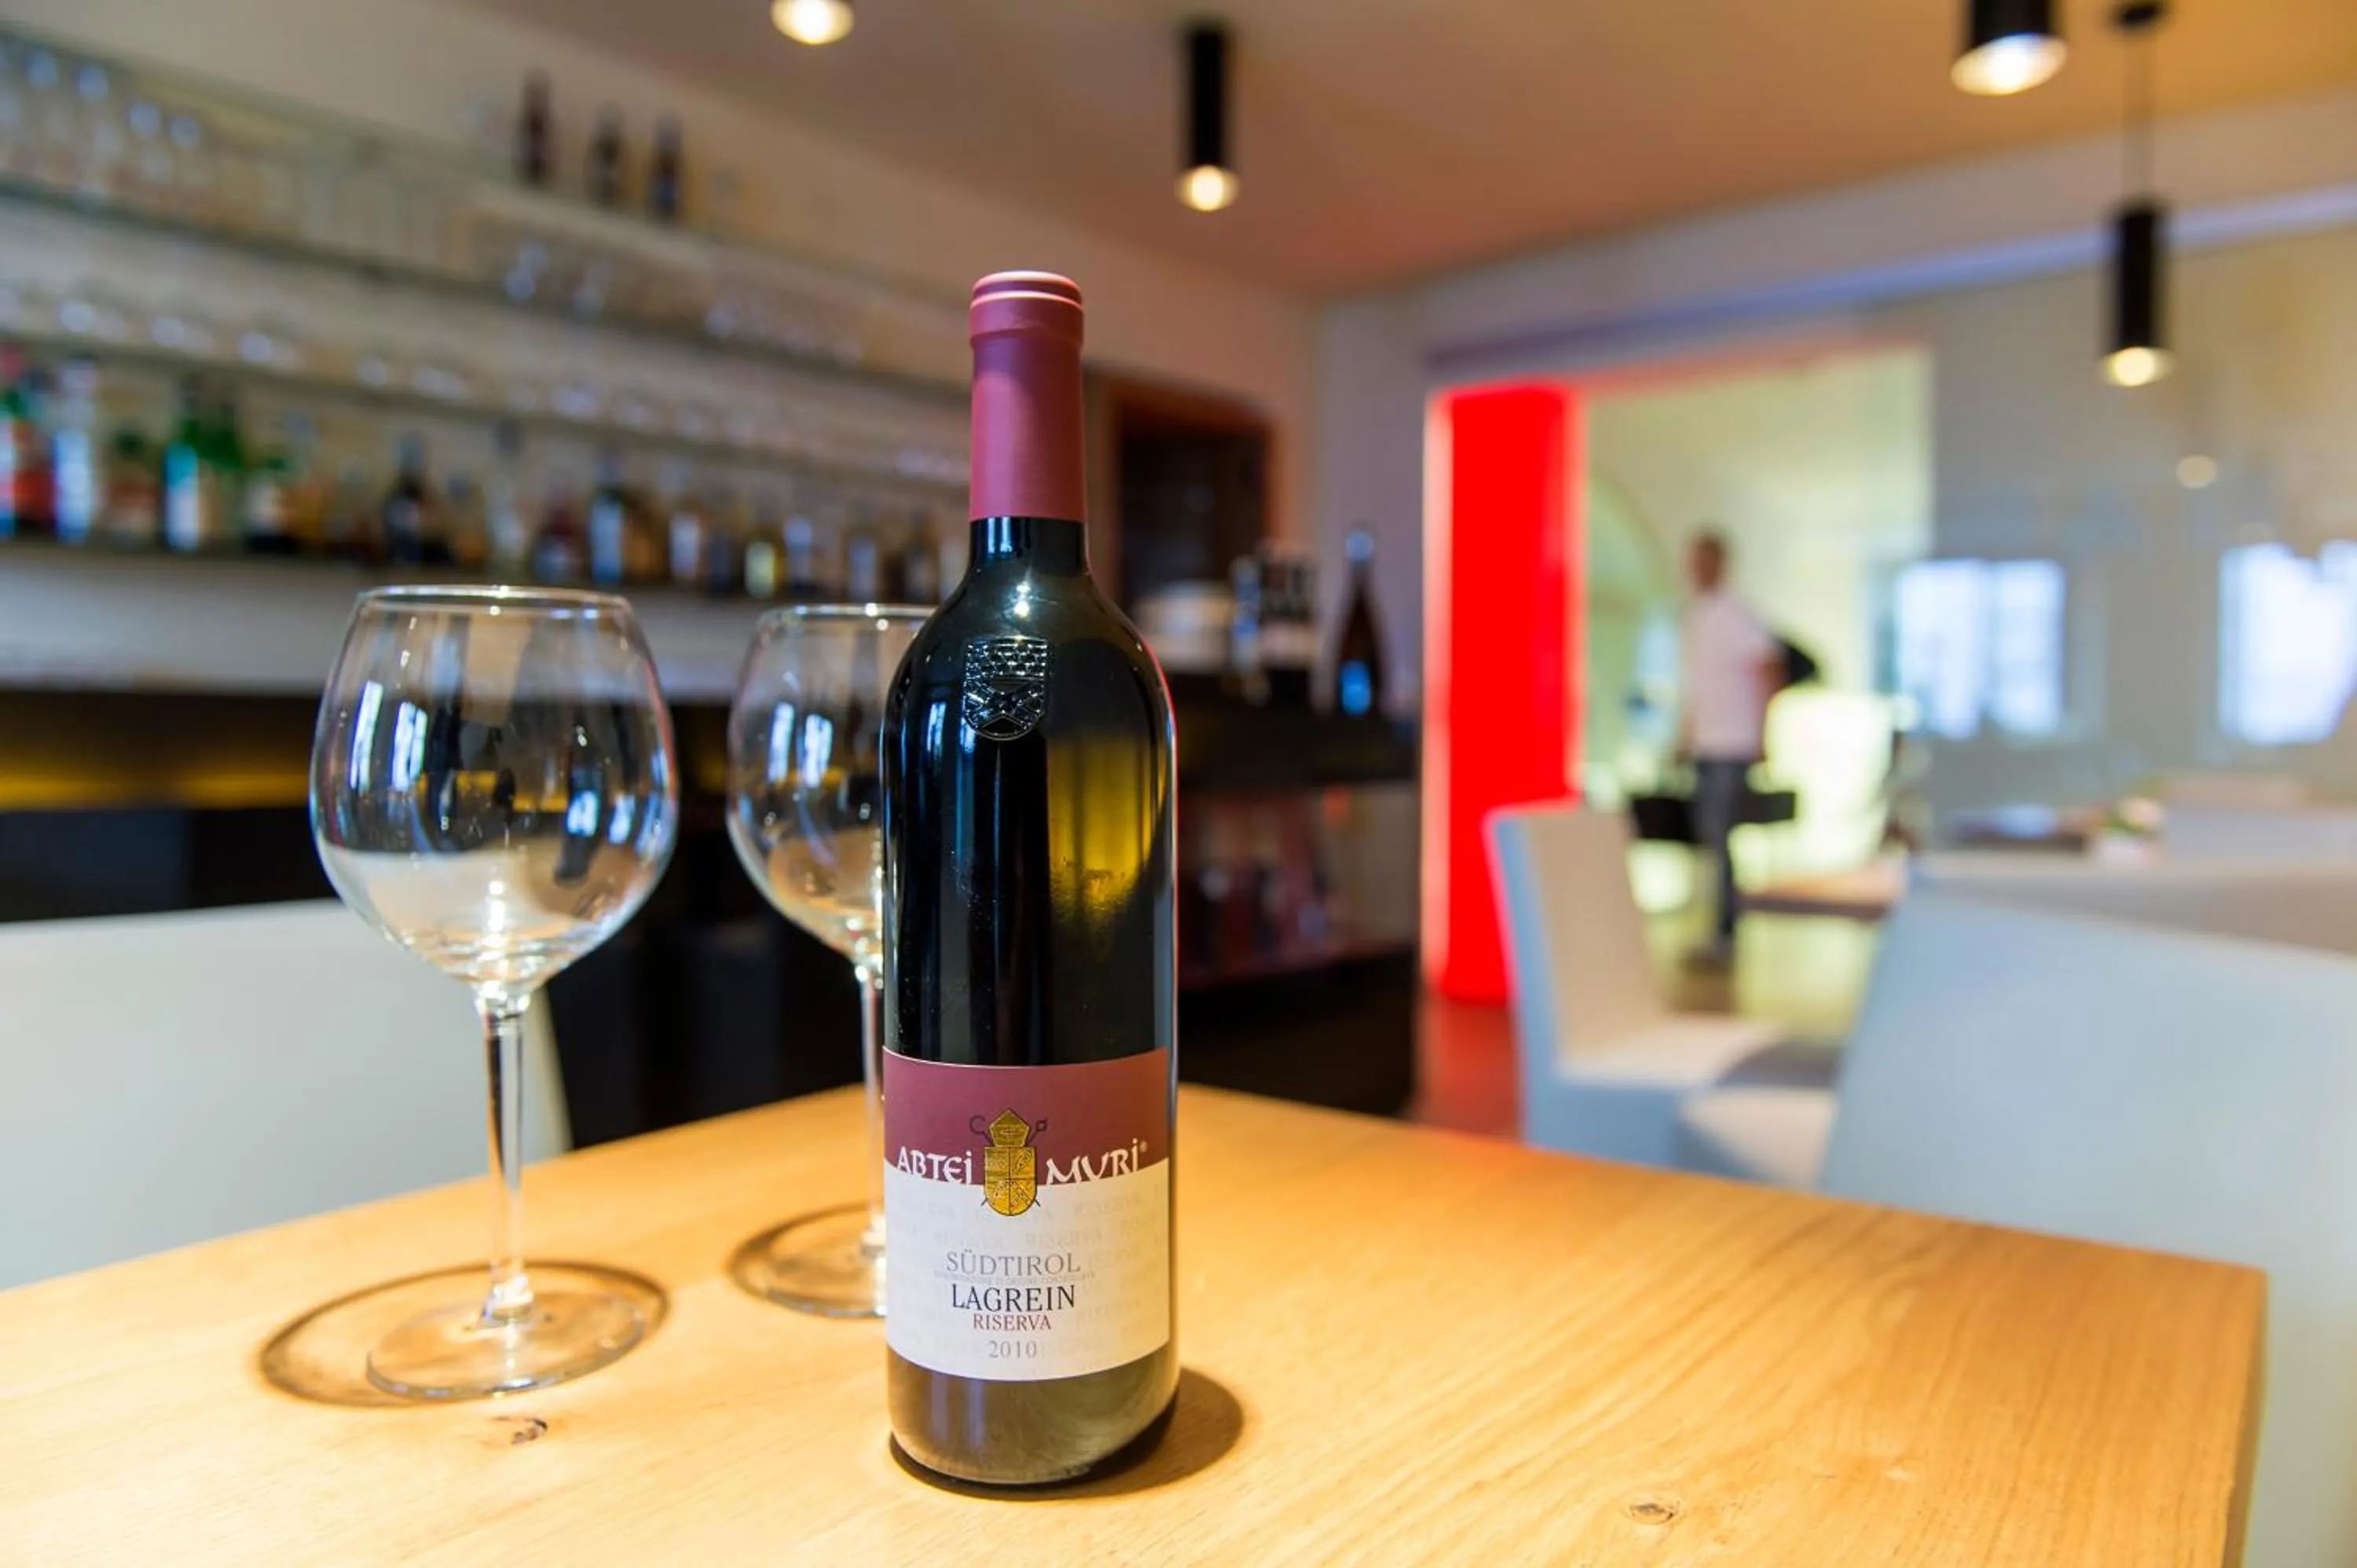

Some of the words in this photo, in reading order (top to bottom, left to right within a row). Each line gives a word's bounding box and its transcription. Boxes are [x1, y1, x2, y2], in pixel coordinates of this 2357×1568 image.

[946, 1249, 1081, 1277] SÜDTIROL
[952, 1284, 1075, 1312] LAGREIN
[973, 1313, 1051, 1331] RISERVA
[988, 1340, 1037, 1358] 2010
